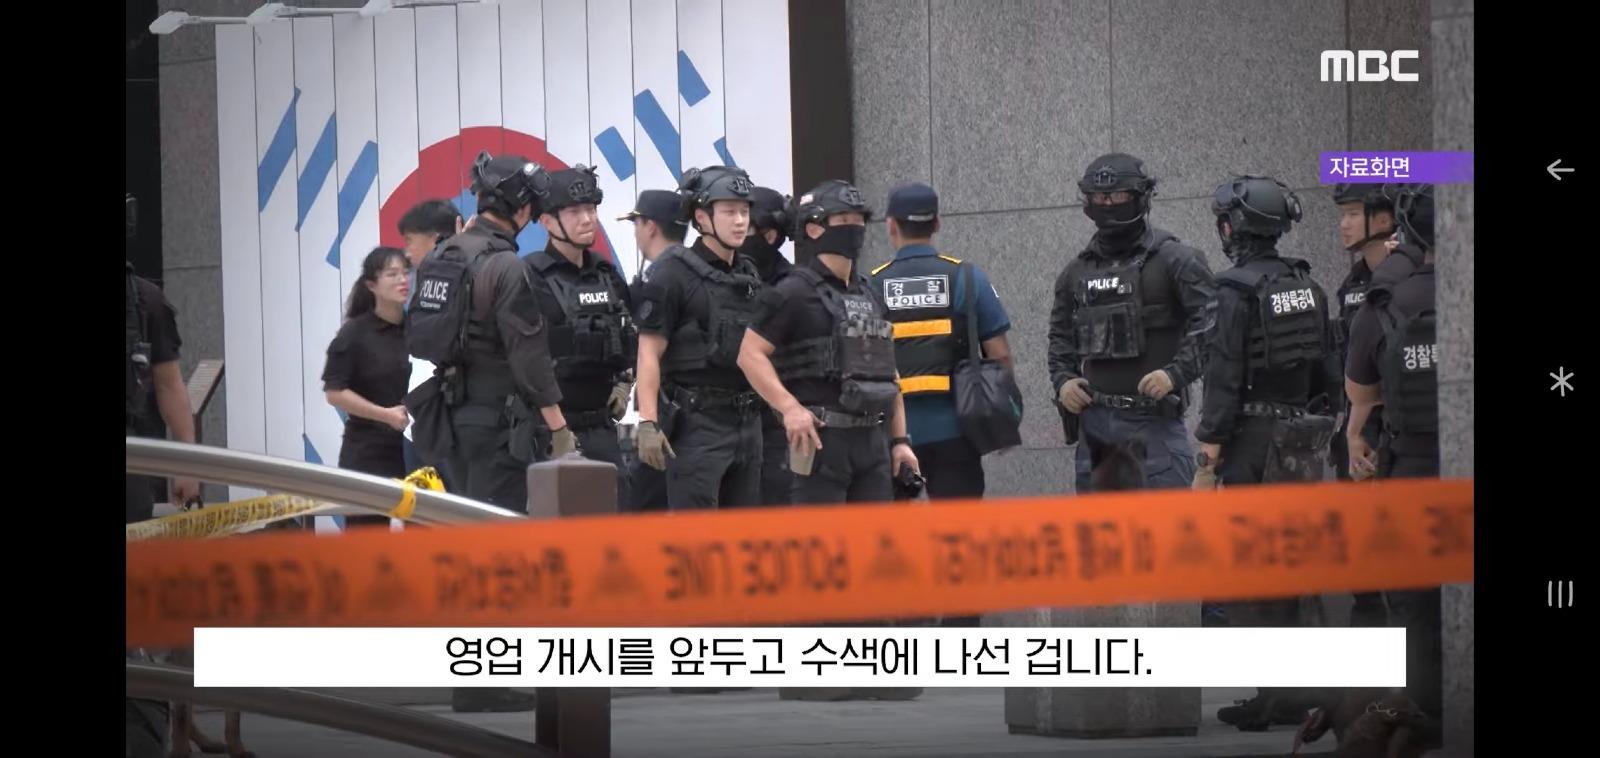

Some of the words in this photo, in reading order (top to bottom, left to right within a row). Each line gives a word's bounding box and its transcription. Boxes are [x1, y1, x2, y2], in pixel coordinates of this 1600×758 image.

[419, 279, 449, 302] POLICE
[1087, 277, 1120, 291] POLICE
[579, 290, 609, 304] POLICE
[844, 297, 873, 311] POLICE
[892, 294, 941, 306] POLICE
[1271, 287, 1316, 314] 경찰특공대
[662, 544, 733, 602] LINE
[740, 537, 848, 597] POLICE
